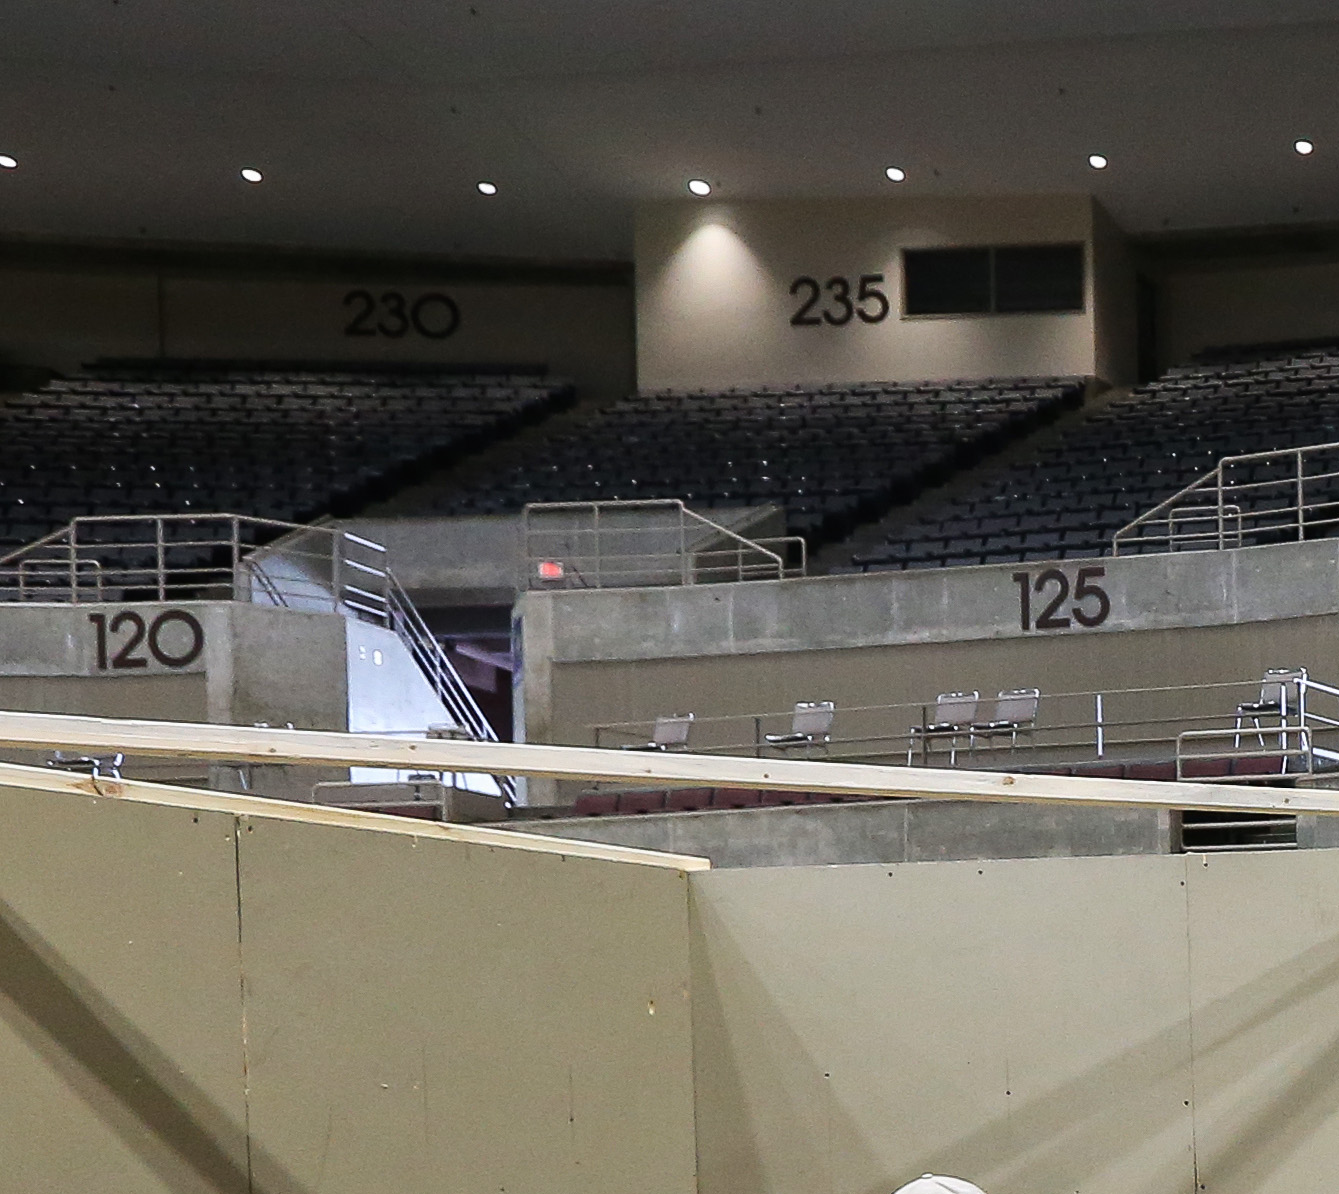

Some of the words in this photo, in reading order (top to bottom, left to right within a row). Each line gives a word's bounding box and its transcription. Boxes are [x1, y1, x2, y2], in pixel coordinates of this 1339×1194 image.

[344, 291, 461, 339] 230
[789, 274, 889, 325] 235
[1012, 567, 1111, 630] 125
[90, 610, 204, 671] 120
